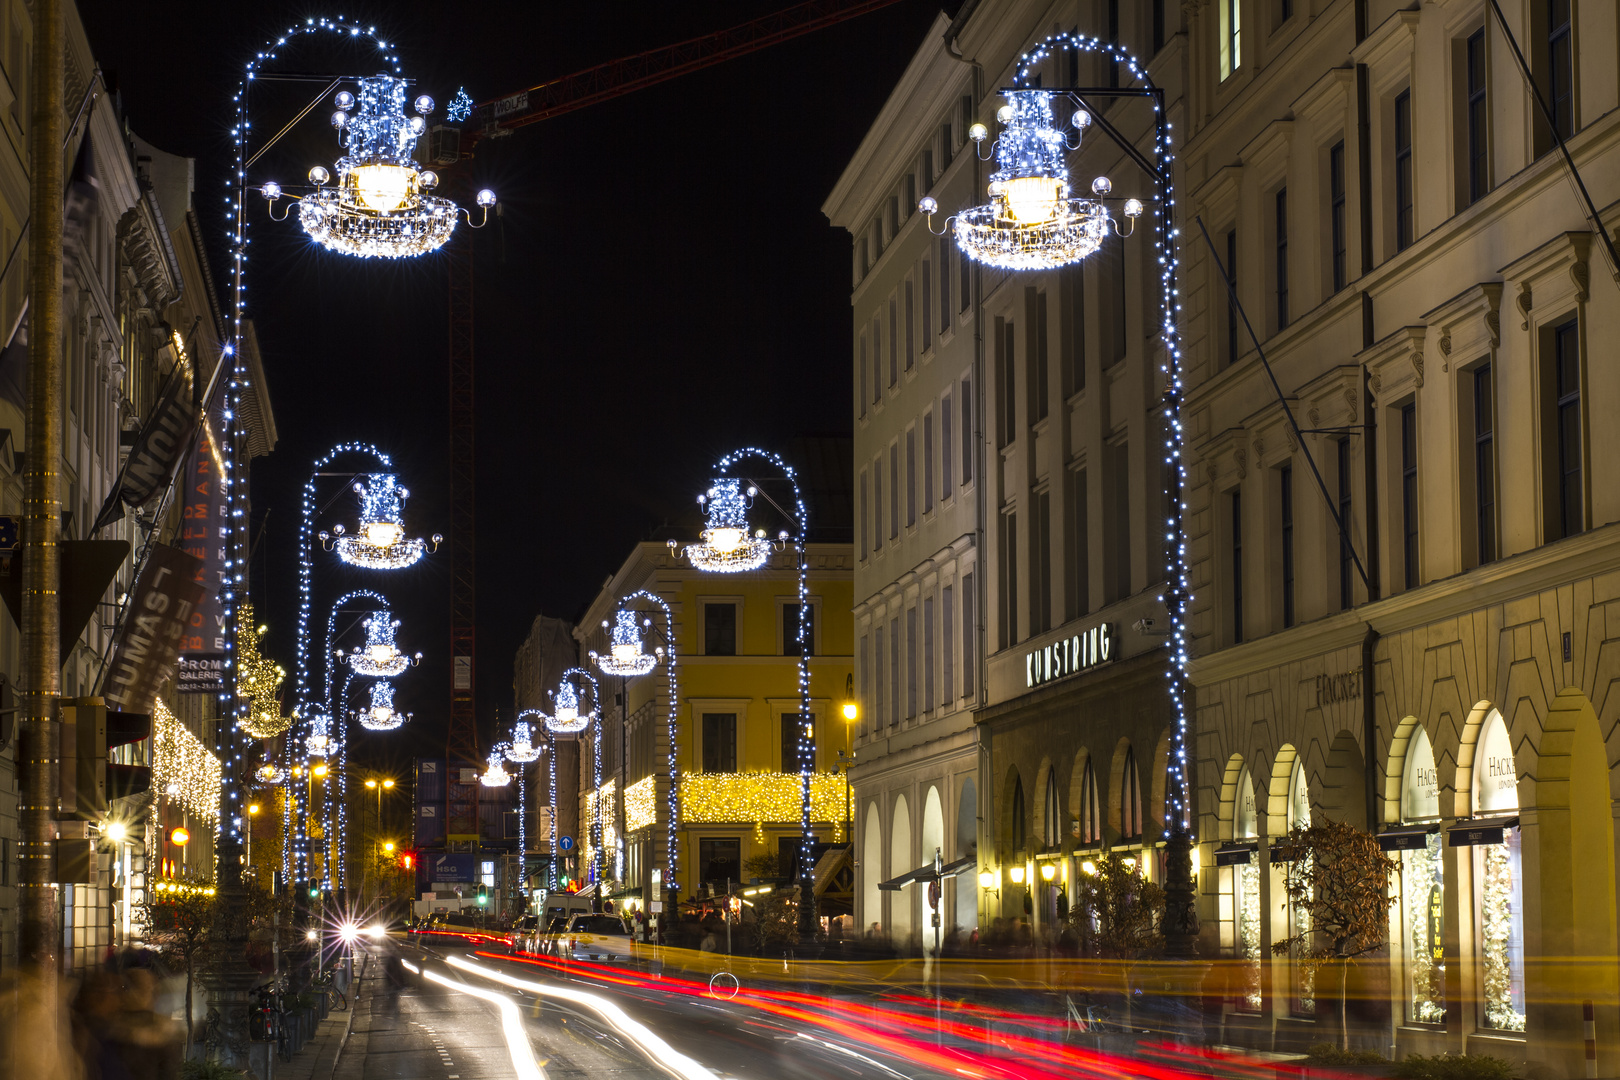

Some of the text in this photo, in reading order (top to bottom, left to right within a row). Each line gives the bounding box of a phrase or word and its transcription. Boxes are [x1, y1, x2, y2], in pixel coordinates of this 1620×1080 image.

[103, 590, 171, 706] LUMAS
[179, 671, 222, 680] GALERIE
[1026, 622, 1110, 688] KUNSTRING
